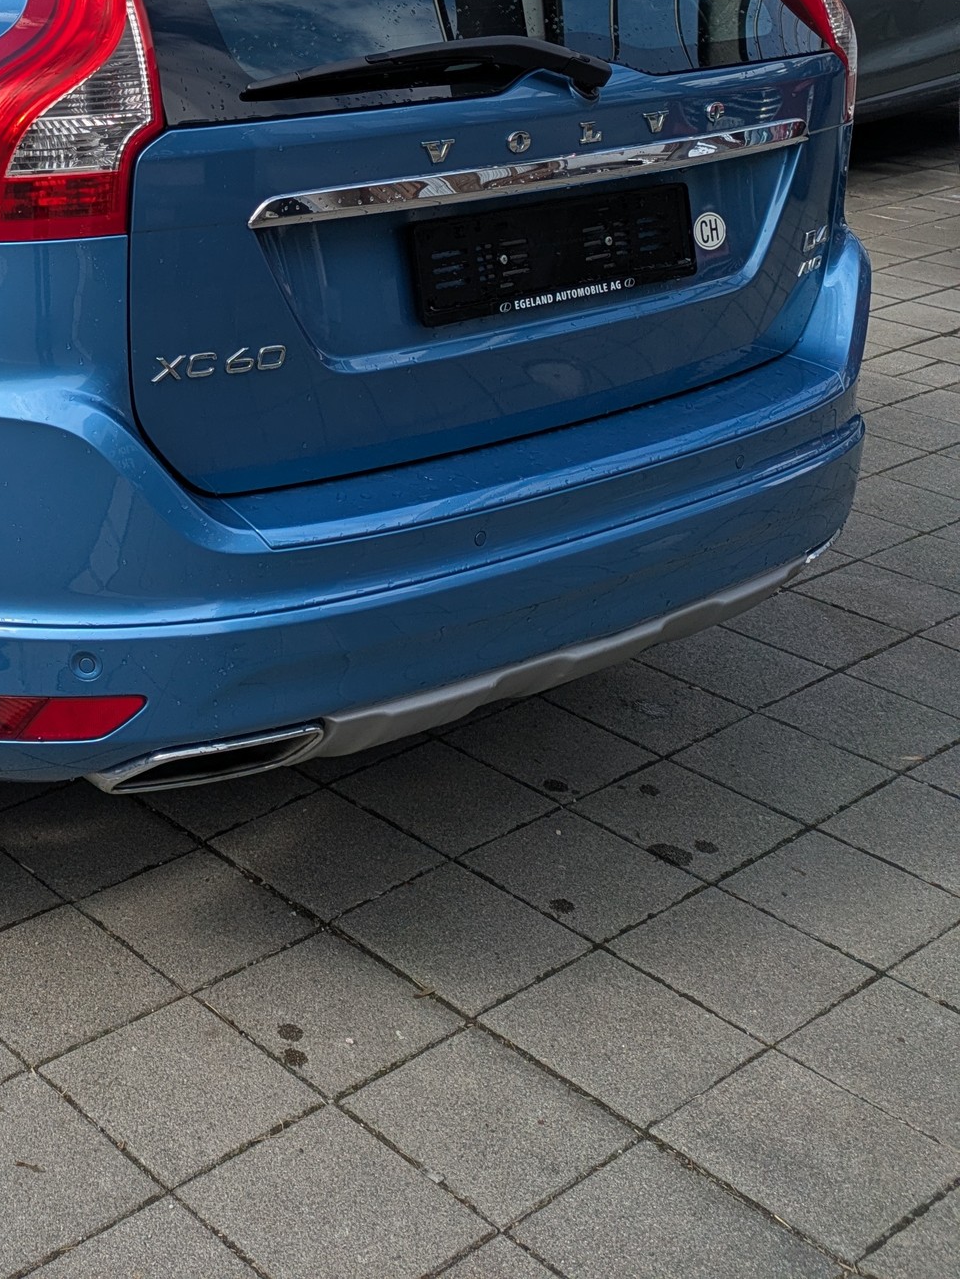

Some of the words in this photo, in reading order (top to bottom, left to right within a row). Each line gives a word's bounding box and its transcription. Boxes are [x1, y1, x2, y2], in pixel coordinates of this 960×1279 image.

[421, 101, 726, 164] VOLVO
[699, 218, 720, 244] CH
[514, 293, 554, 310] EGELAND
[555, 282, 609, 302] AUTOMOBILE
[610, 280, 622, 292] AG
